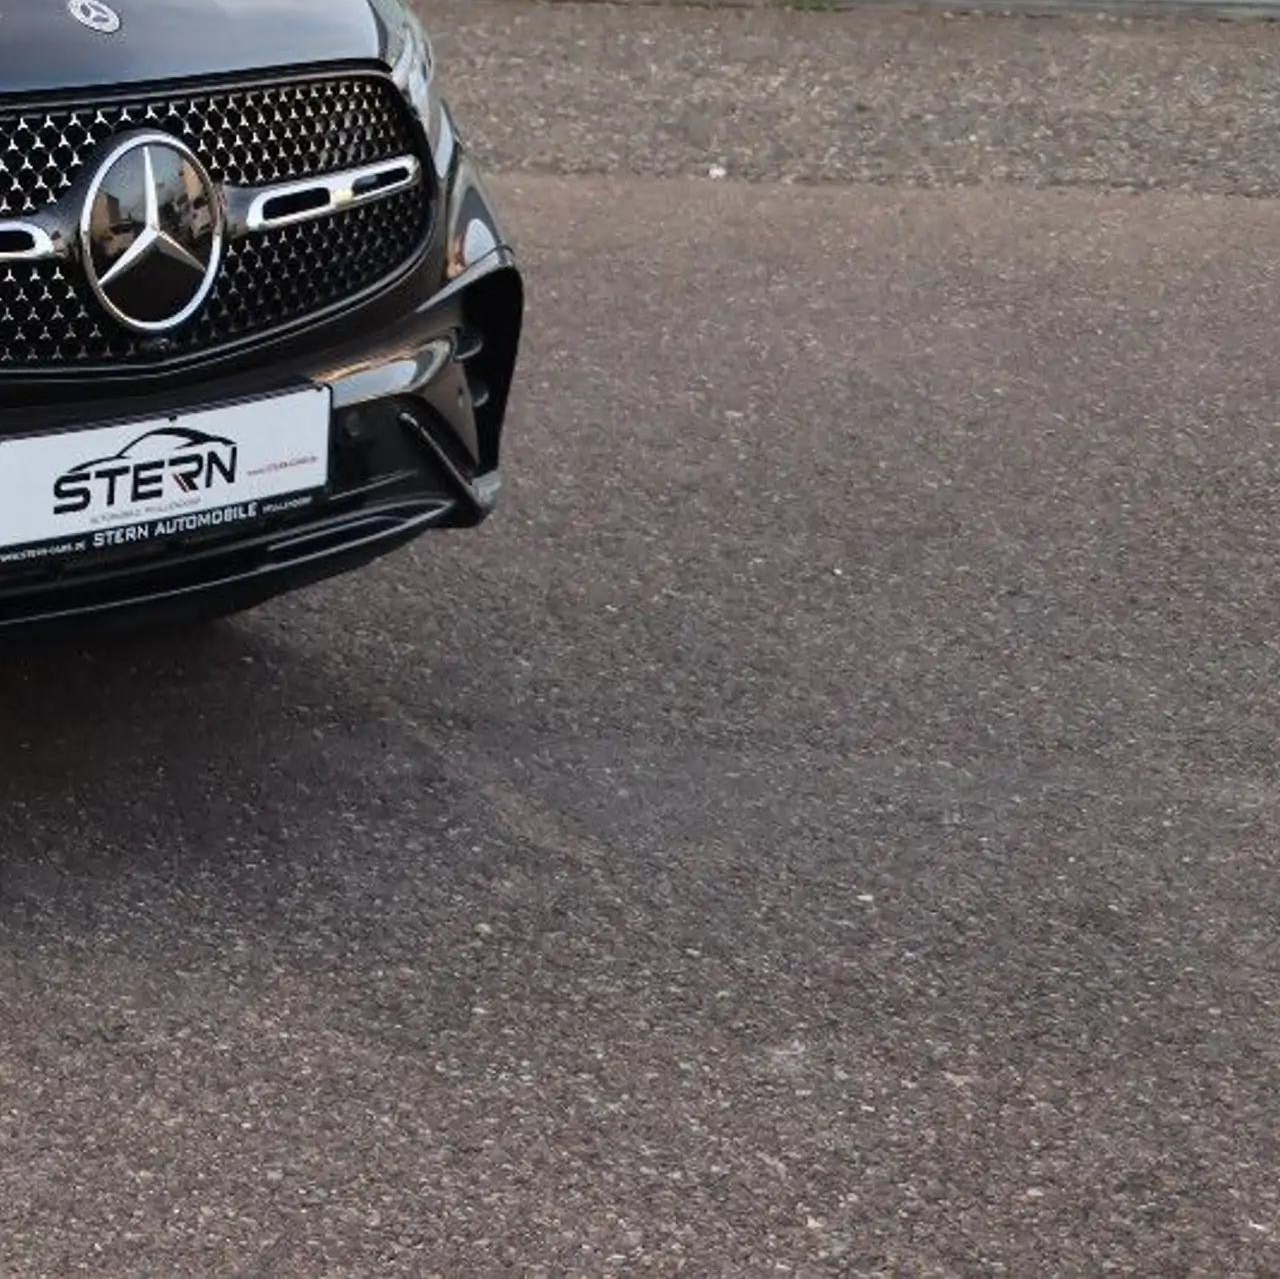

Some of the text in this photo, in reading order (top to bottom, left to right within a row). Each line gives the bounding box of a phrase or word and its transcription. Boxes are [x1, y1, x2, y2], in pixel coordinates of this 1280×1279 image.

[53, 446, 237, 514] STERN
[92, 524, 149, 547] STERN
[154, 502, 258, 537] AUTOMOBILE
